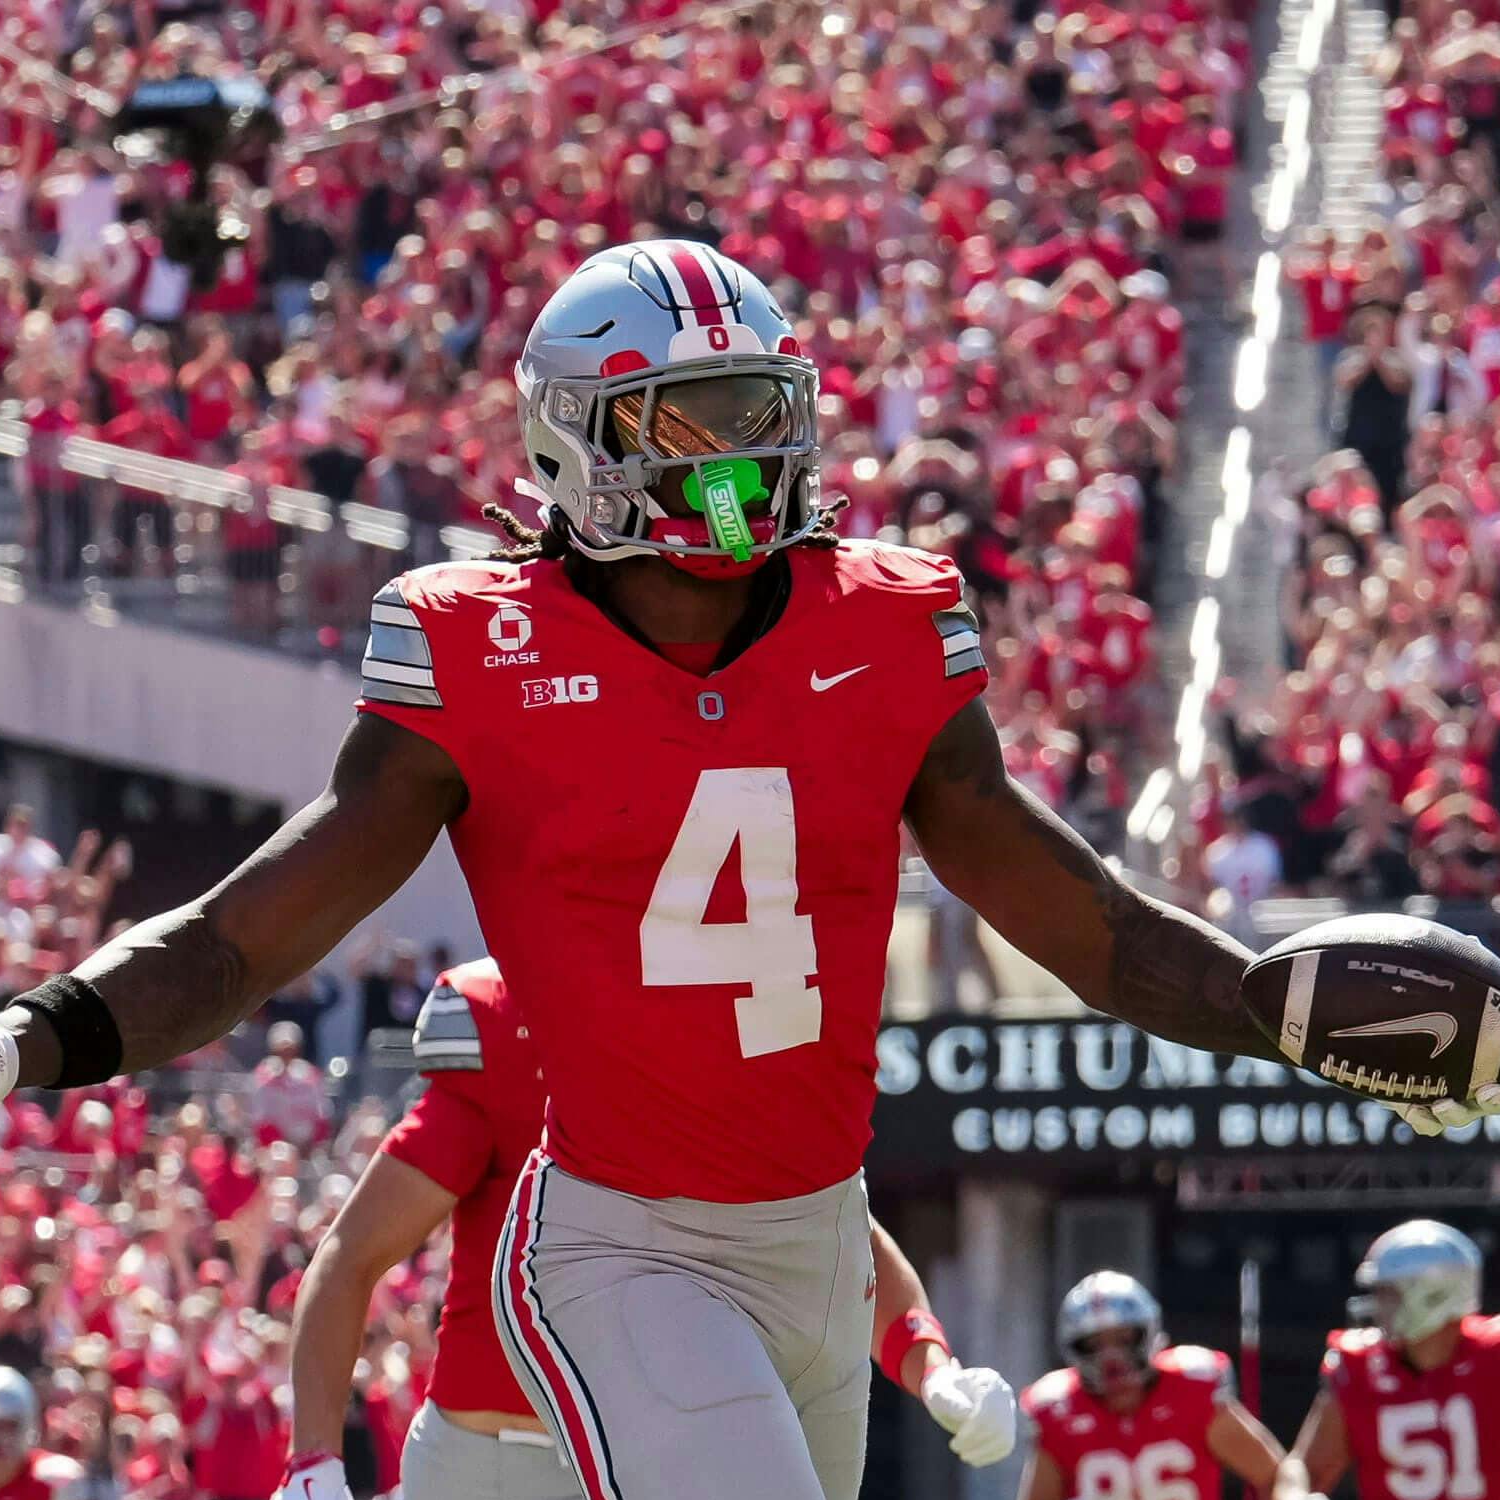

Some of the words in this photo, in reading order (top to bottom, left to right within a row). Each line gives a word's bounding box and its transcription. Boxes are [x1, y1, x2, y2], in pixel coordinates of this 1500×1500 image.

[712, 487, 747, 548] SMITH
[484, 651, 541, 668] CHASE
[639, 766, 823, 1059] 4
[952, 1103, 1197, 1153] CUSTOM
[1219, 1100, 1415, 1148] BUILT.
